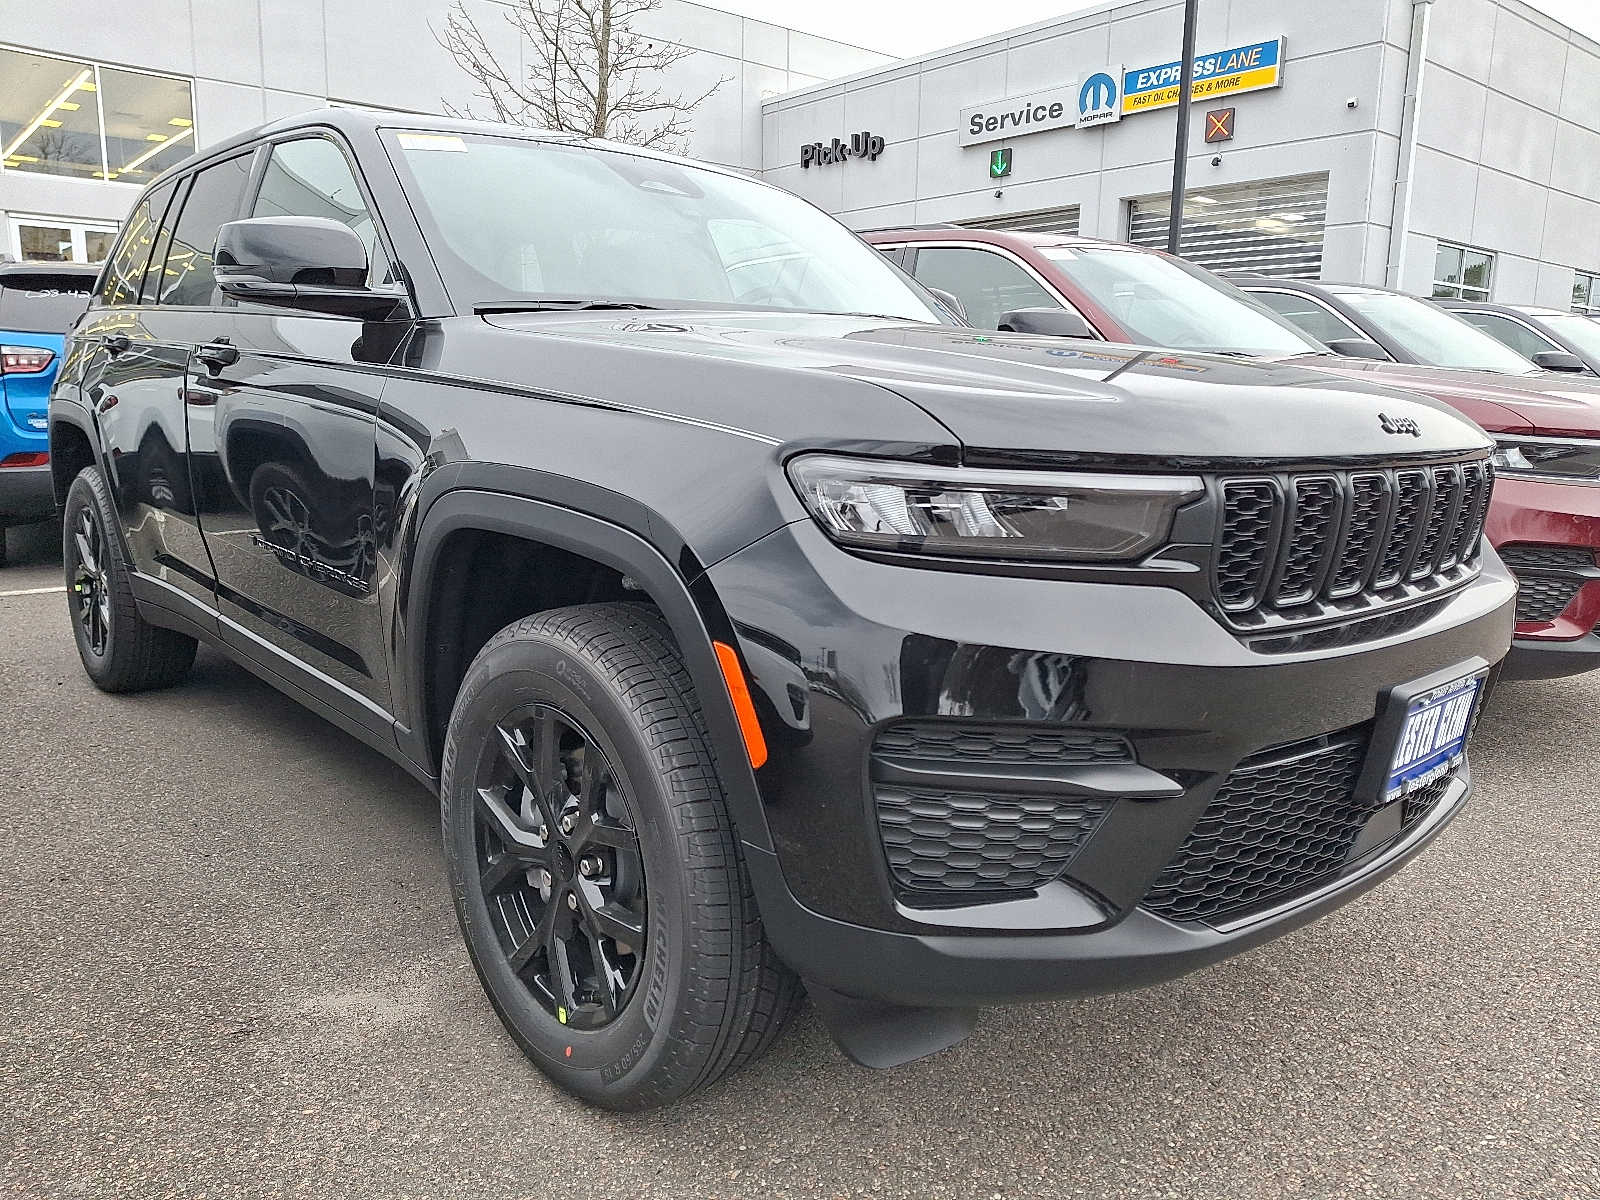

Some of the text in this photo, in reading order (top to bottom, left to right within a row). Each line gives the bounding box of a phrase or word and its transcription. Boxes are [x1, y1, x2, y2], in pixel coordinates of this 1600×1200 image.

[1136, 47, 1262, 89] EXPRSSLANE
[1132, 94, 1152, 106] FAST
[1153, 91, 1165, 103] OIL
[1206, 82, 1212, 91] &
[1215, 76, 1241, 89] MORE
[969, 101, 1064, 136] Service
[1079, 111, 1113, 124] MOPAR
[800, 131, 885, 169] Pick-Up
[1378, 412, 1421, 438] Jeep
[645, 892, 668, 1023] MICHELIN
